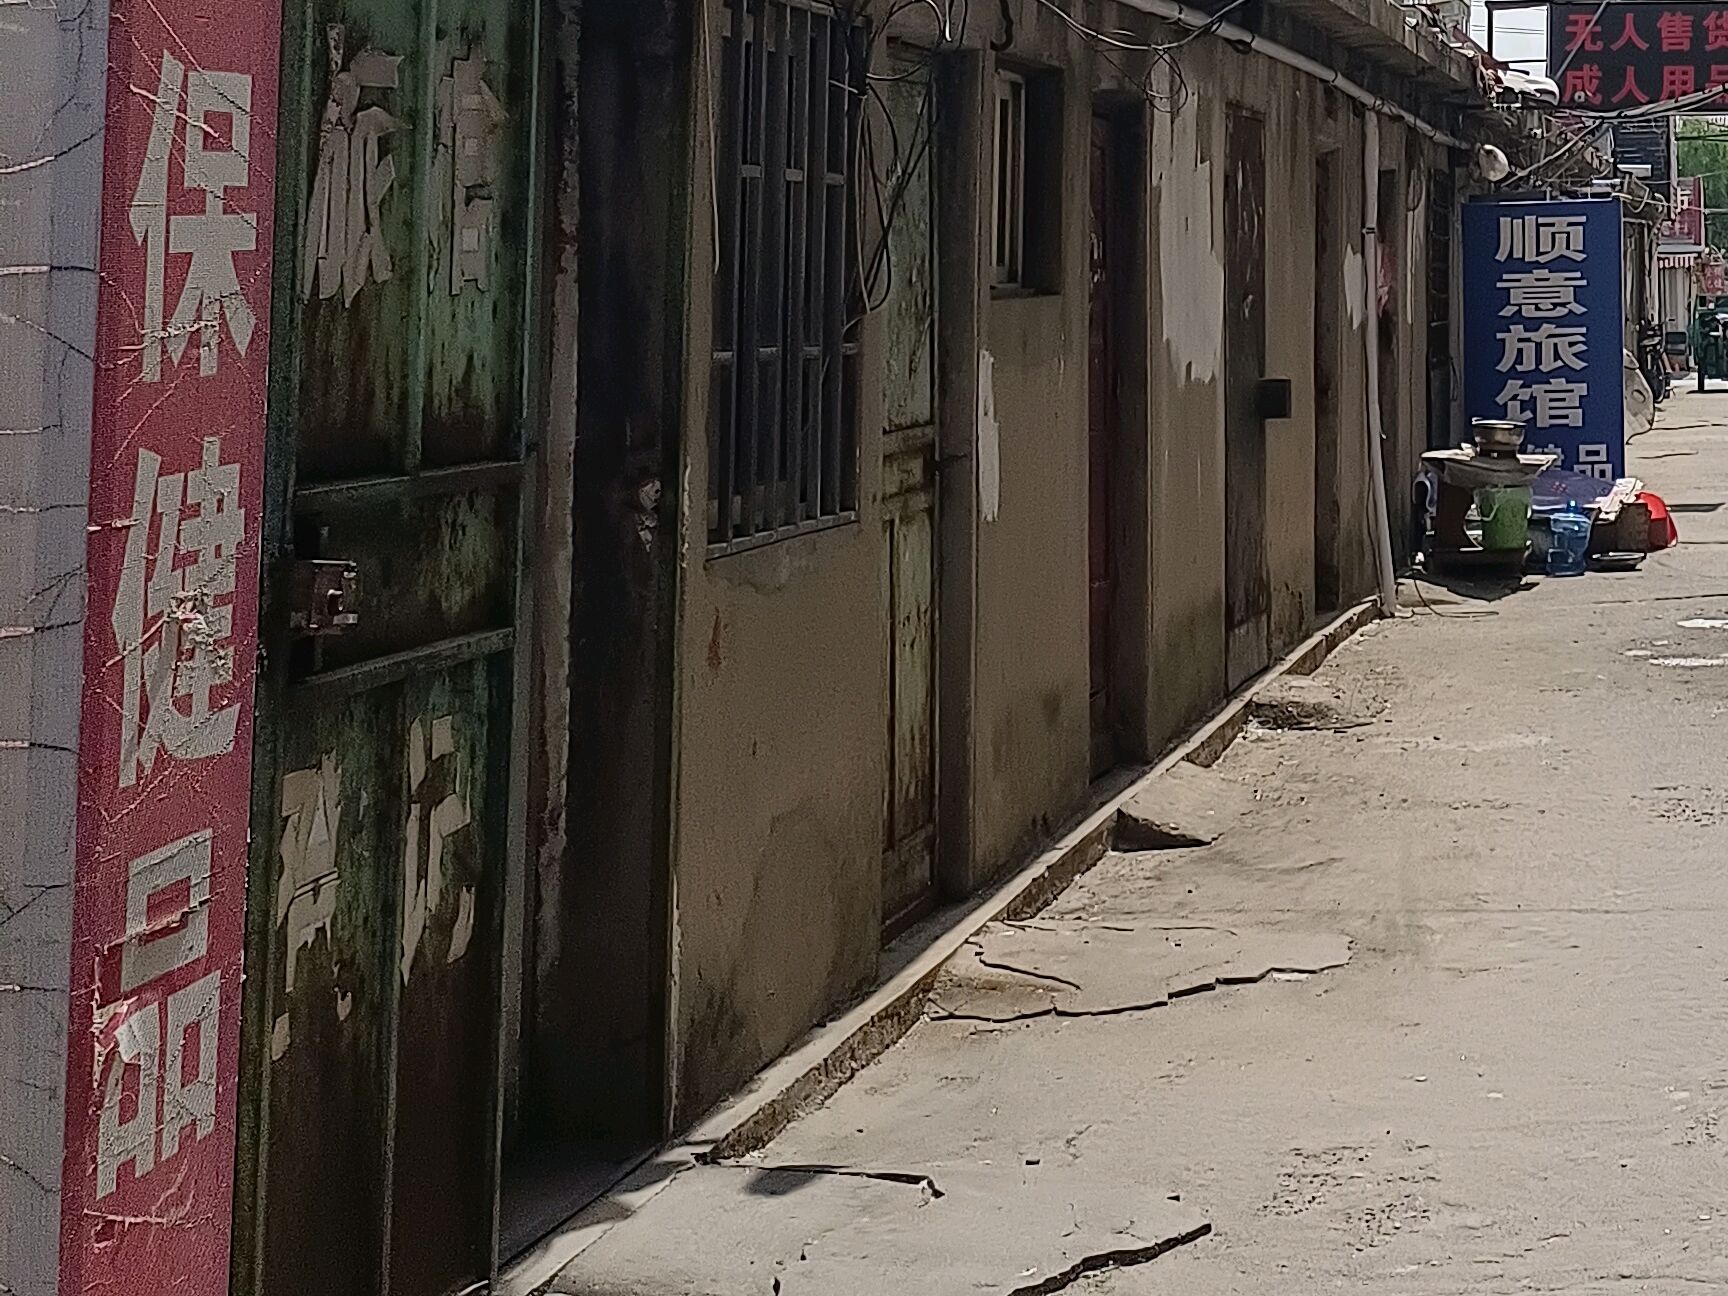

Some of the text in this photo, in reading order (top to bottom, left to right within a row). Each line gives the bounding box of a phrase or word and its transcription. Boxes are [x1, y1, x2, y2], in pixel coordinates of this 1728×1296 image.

[97, 48, 260, 1200] 保健品
[1495, 214, 1589, 428] 顺意旅馆
